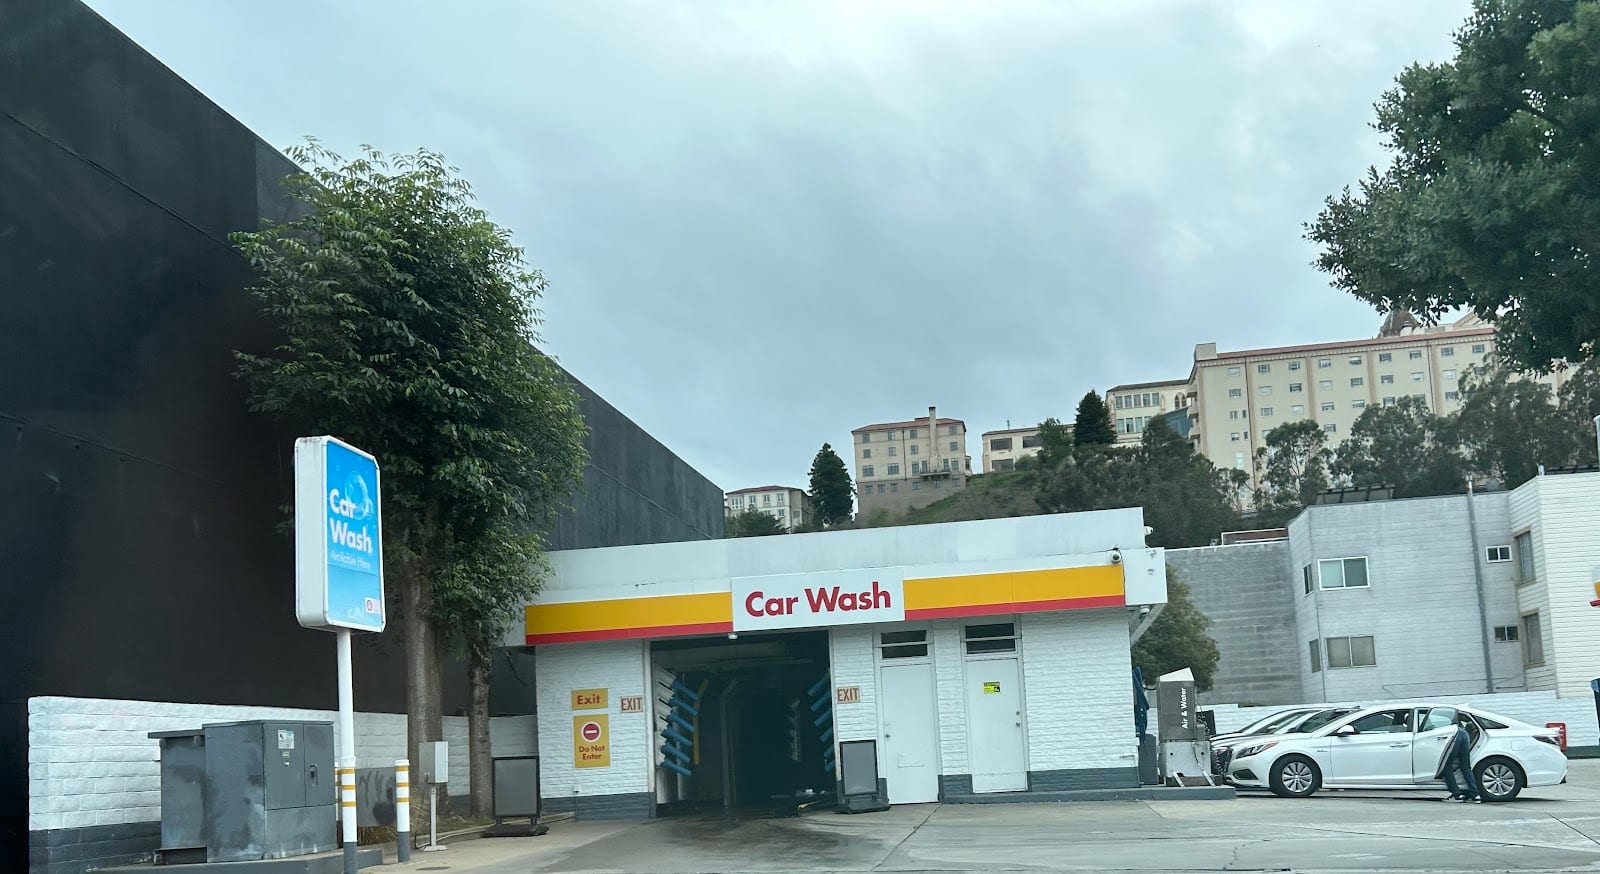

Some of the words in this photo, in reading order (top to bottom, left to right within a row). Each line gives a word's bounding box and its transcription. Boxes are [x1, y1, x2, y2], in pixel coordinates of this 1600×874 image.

[329, 488, 356, 519] Car
[329, 517, 373, 555] Wash
[745, 591, 799, 618] Car
[804, 581, 892, 613] Wash
[577, 694, 601, 705] Exit
[837, 687, 859, 702] EXIT
[1180, 687, 1188, 709] Water
[621, 697, 643, 711] EXIT
[1181, 718, 1189, 729] Air
[578, 745, 590, 753] Do
[591, 744, 606, 753] Not
[582, 753, 602, 761] Enter
